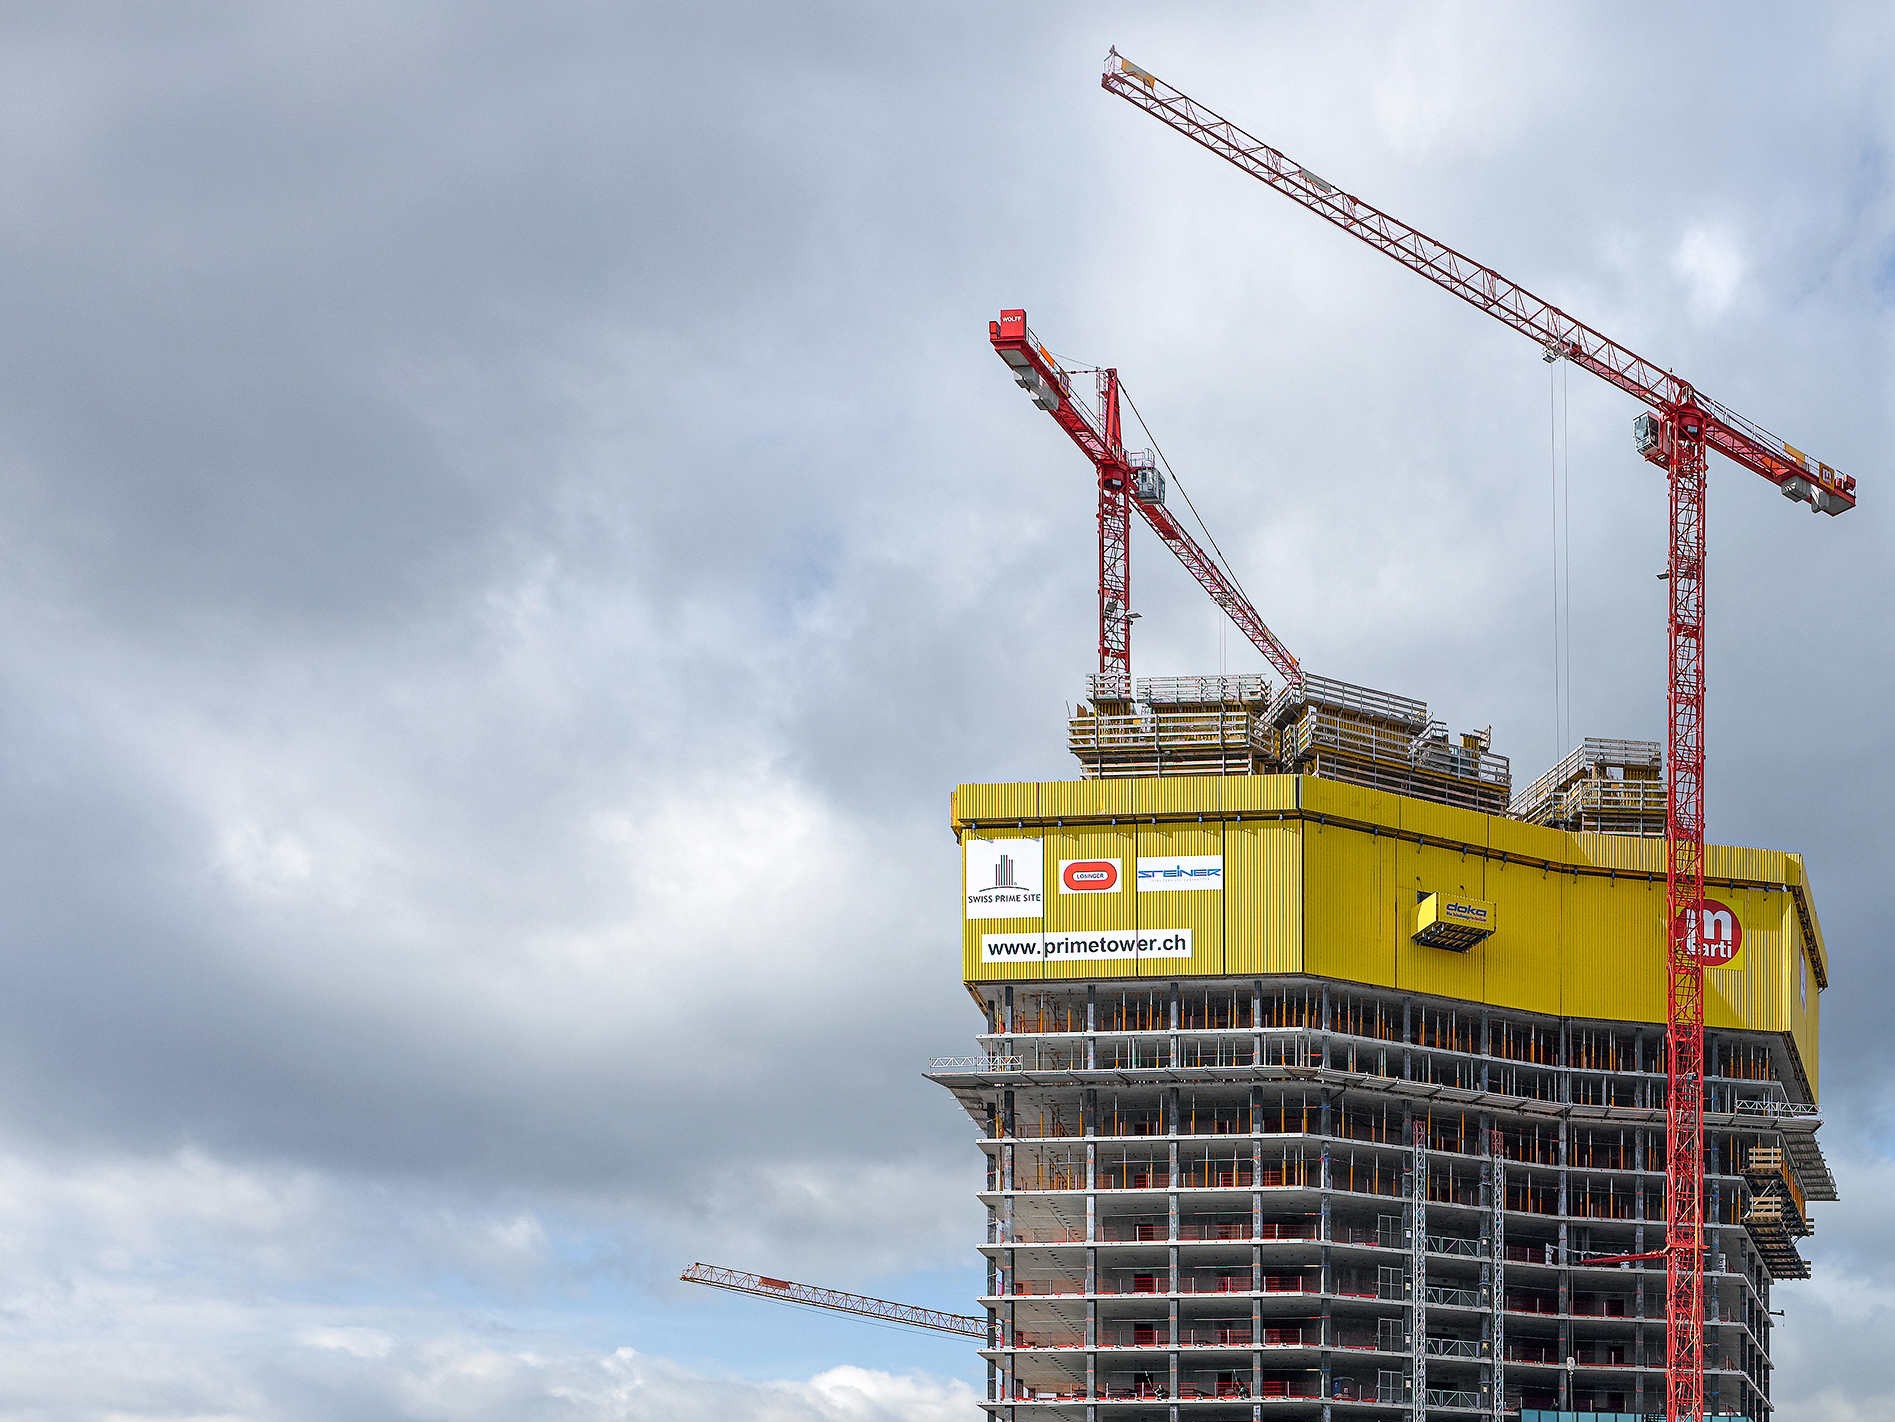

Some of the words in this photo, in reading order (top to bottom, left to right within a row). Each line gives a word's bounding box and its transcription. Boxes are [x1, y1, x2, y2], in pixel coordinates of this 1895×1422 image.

[968, 894, 993, 904] SWISS
[995, 893, 1021, 903] PRIME
[1023, 893, 1041, 902] SITE
[1446, 902, 1487, 917] doka
[988, 934, 1186, 958] www.primetower.ch
